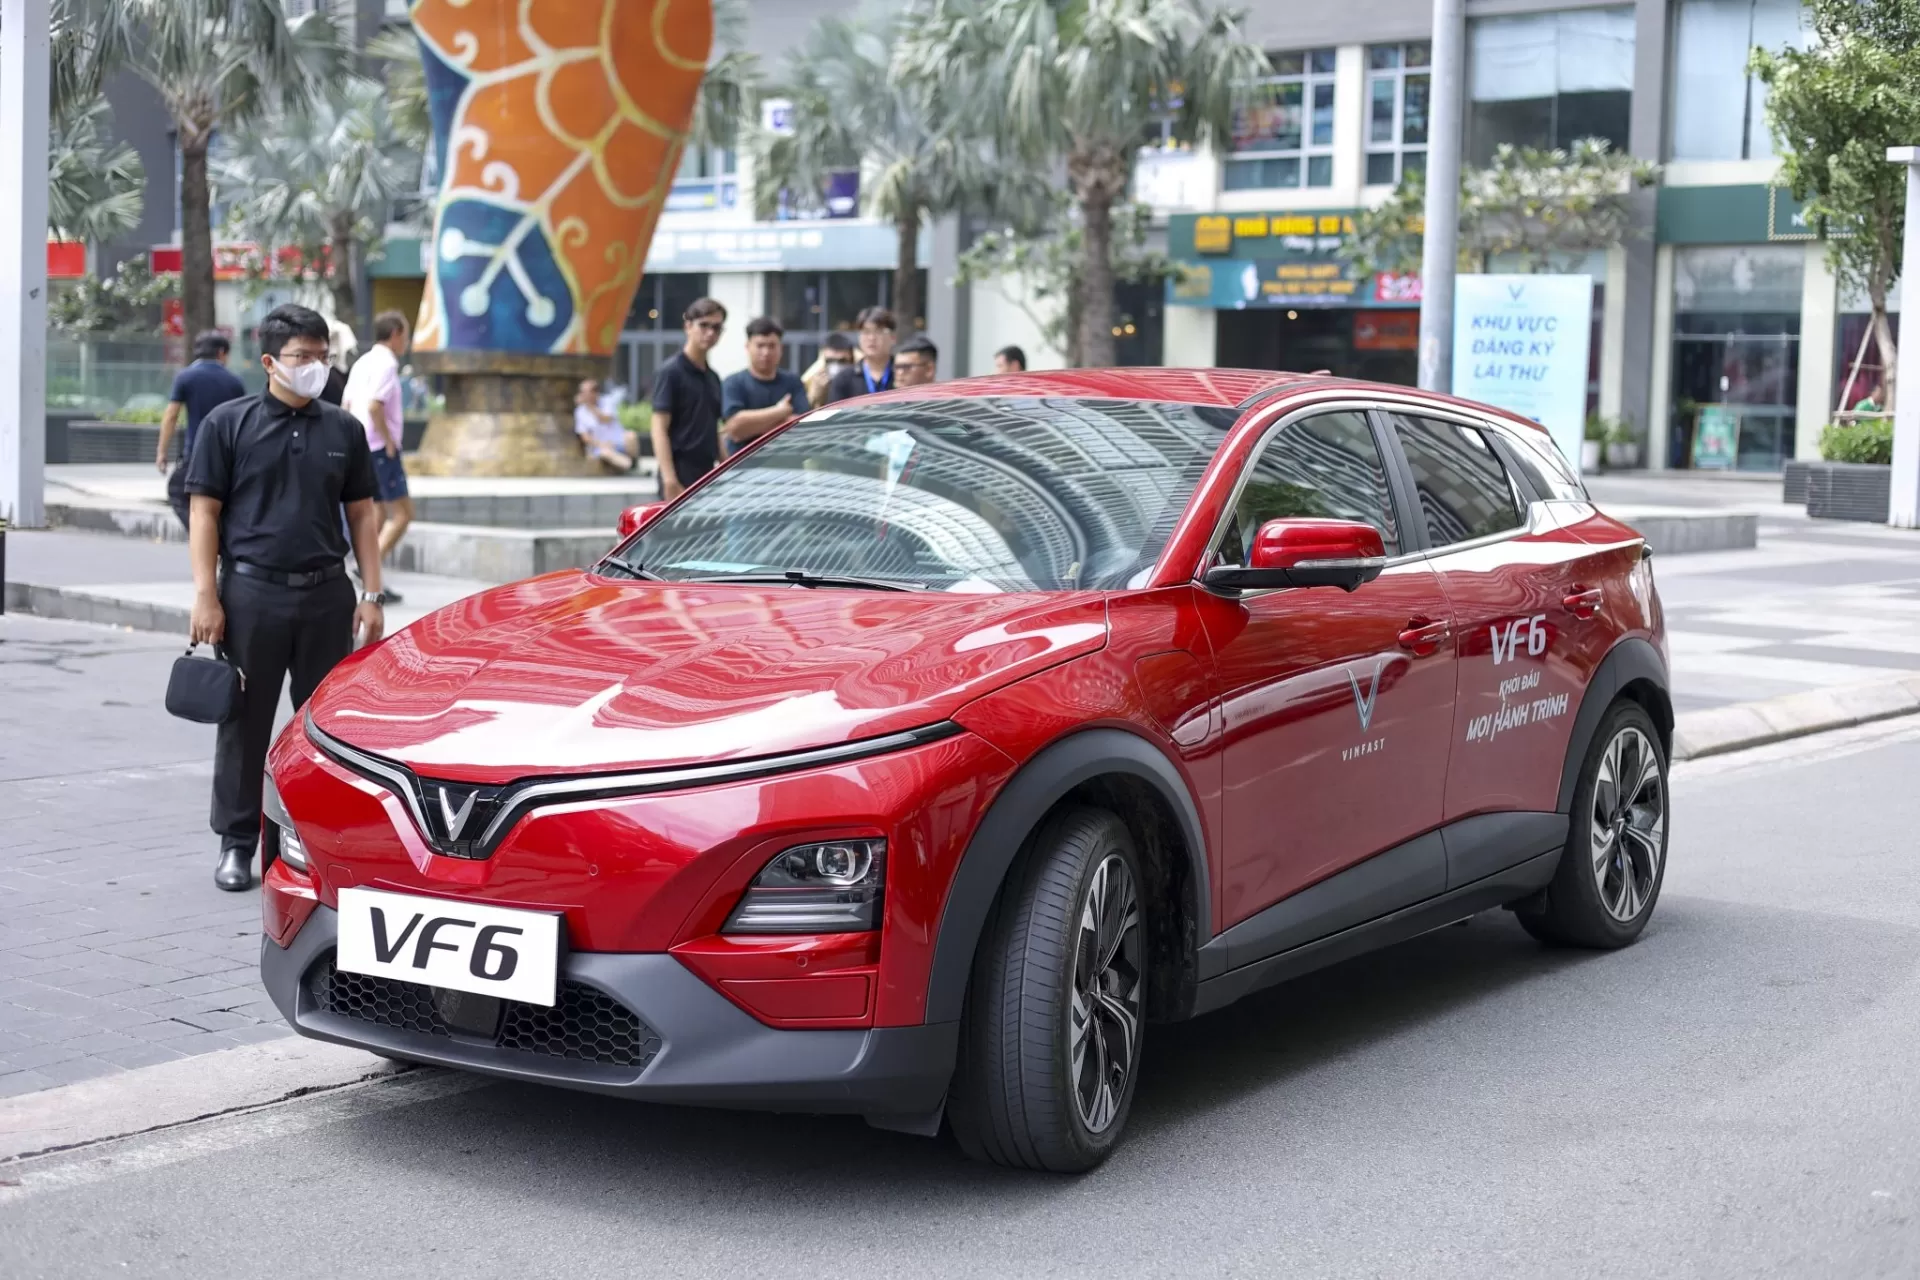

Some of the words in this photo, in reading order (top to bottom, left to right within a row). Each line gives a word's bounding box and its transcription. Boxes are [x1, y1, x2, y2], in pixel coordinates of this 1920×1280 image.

[1471, 315, 1511, 331] KHU
[1517, 315, 1557, 334] VỰC
[1489, 614, 1546, 666] VF6
[1466, 712, 1493, 743] MỌI
[1491, 702, 1529, 742] HÀNH
[1531, 692, 1569, 723] TRÌNH
[1342, 737, 1386, 762] VINFAST
[369, 906, 524, 982] VF6
